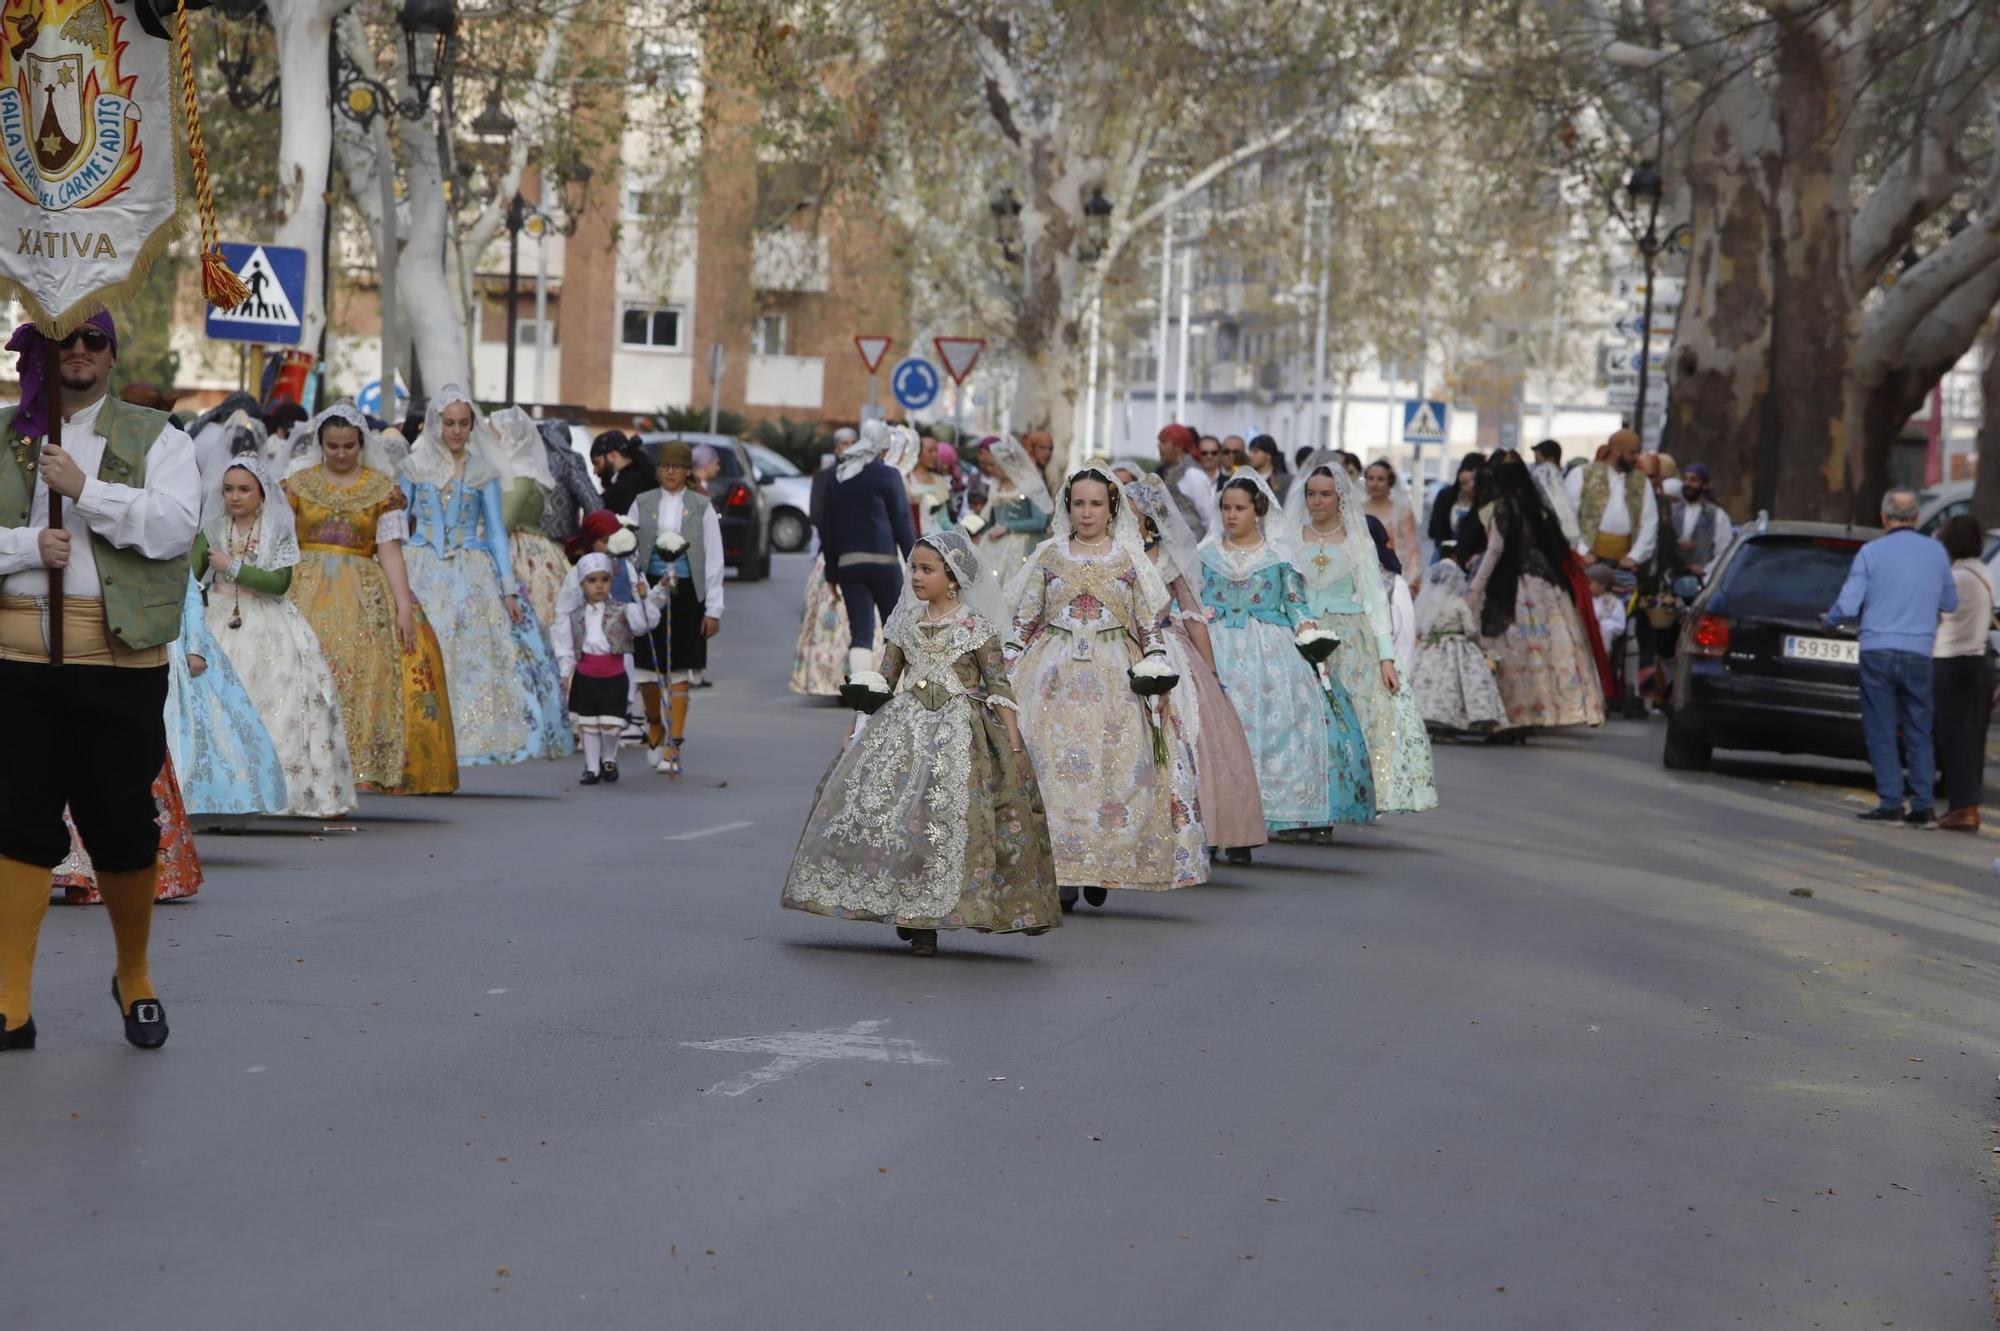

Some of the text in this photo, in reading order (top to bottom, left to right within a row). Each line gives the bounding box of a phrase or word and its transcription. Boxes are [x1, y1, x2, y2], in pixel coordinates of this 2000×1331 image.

[0, 90, 22, 147] FALLA
[58, 159, 107, 204] CARME
[17, 227, 117, 259] XATIVA
[1797, 640, 1840, 658] 5939
